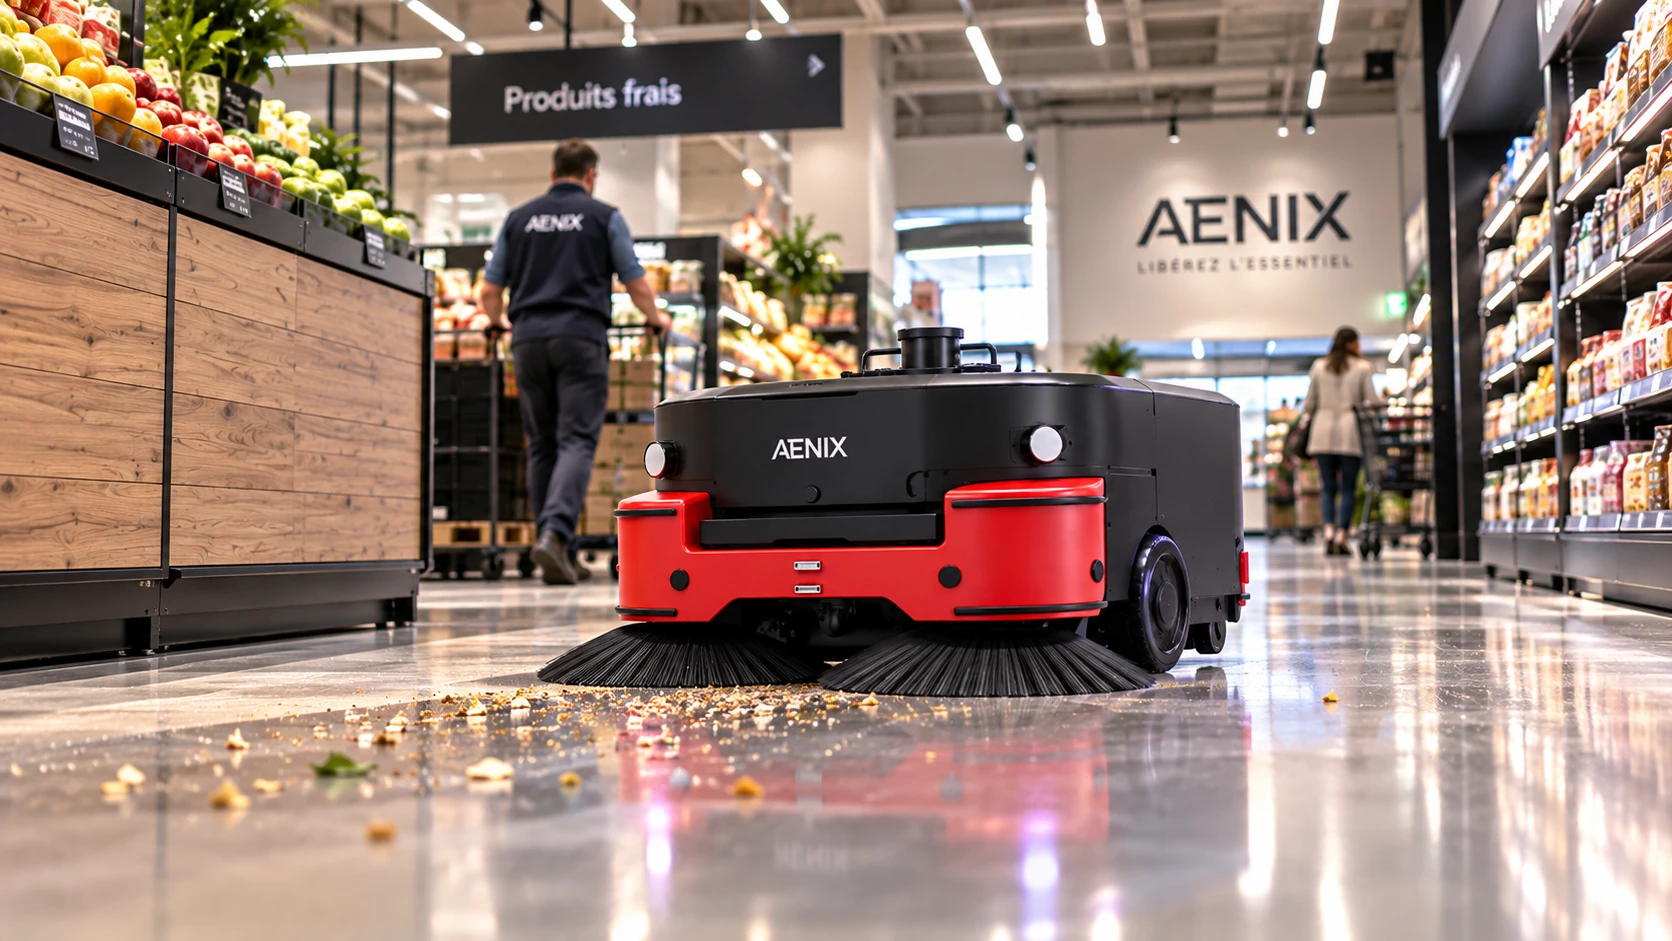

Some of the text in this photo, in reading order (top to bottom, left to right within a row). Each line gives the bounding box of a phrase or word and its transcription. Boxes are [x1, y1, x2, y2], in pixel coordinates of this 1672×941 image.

[503, 77, 683, 114] Produits frais
[525, 213, 585, 233] AENIX
[1137, 190, 1352, 247] AENIX
[1137, 253, 1353, 275] LIBÉREZ L'ESSENTIEL
[771, 436, 849, 460] AENIX
